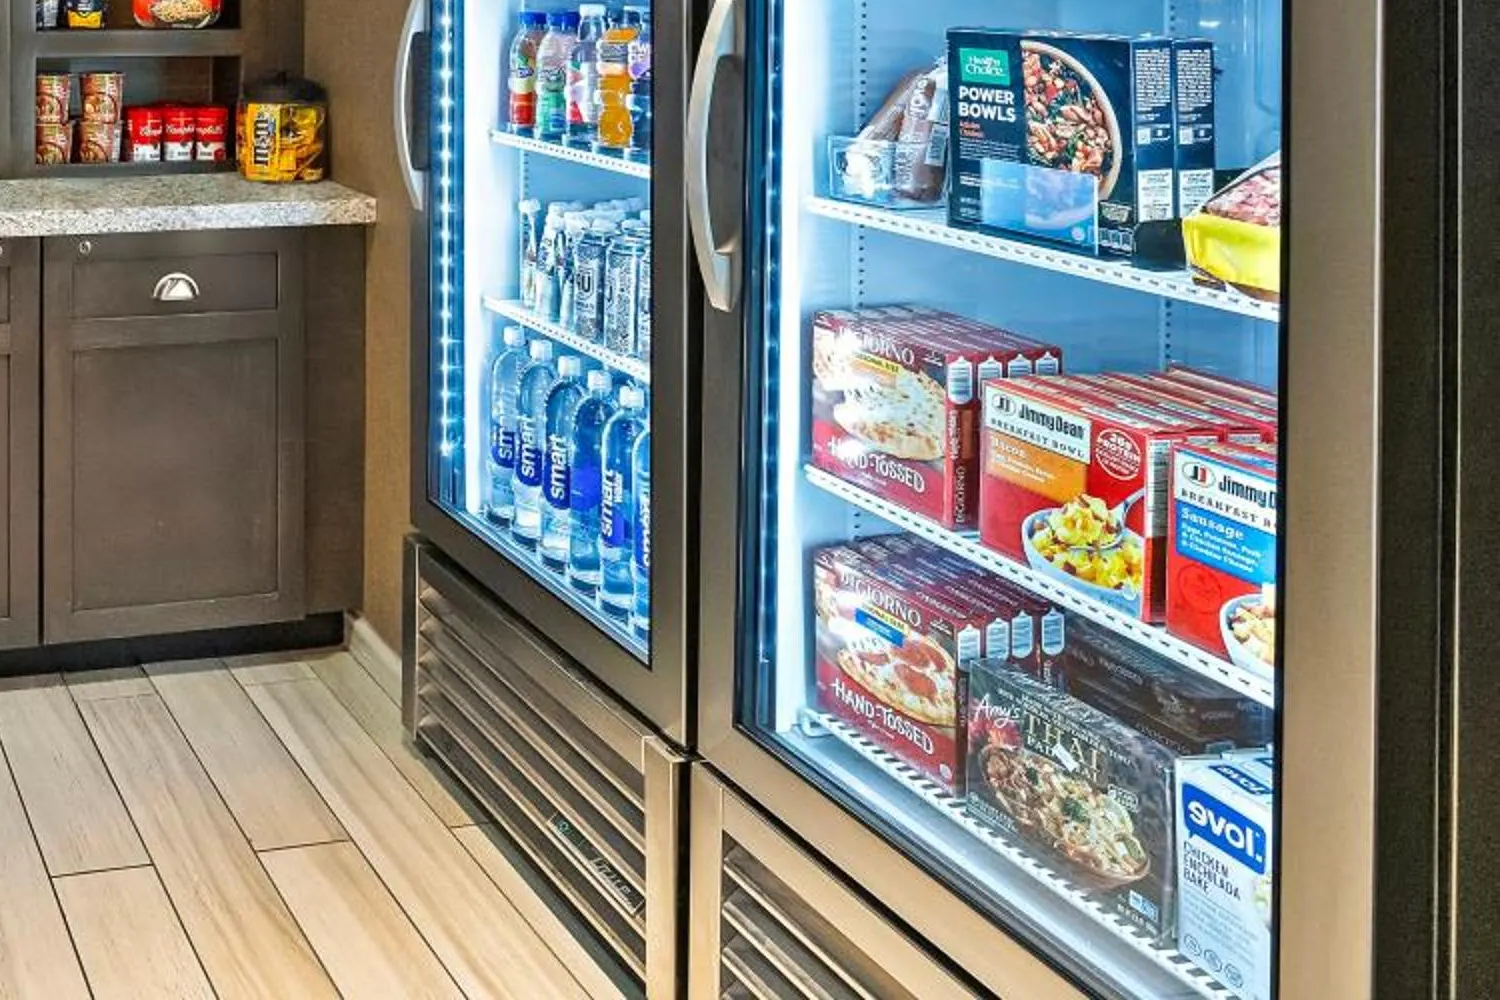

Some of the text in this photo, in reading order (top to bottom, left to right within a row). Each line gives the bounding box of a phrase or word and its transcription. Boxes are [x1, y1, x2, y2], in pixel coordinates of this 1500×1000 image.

[958, 85, 1015, 105] POWER
[958, 102, 1017, 123] BOWLS
[1056, 415, 1085, 440] Dean
[519, 414, 537, 479] smart
[826, 436, 926, 494] HND-TOSSED
[549, 433, 567, 501] smart
[1181, 487, 1259, 523] BREAKFAST
[1218, 474, 1267, 509] Jimmy
[1181, 507, 1245, 542] Sausage
[829, 677, 935, 756] HAND-TOSSED
[973, 692, 1022, 729] Amy's
[1023, 710, 1100, 783] THAI
[1183, 840, 1230, 879] CHICKEN
[1183, 855, 1242, 901] ENCHILADA
[1183, 869, 1210, 895] BAKE
